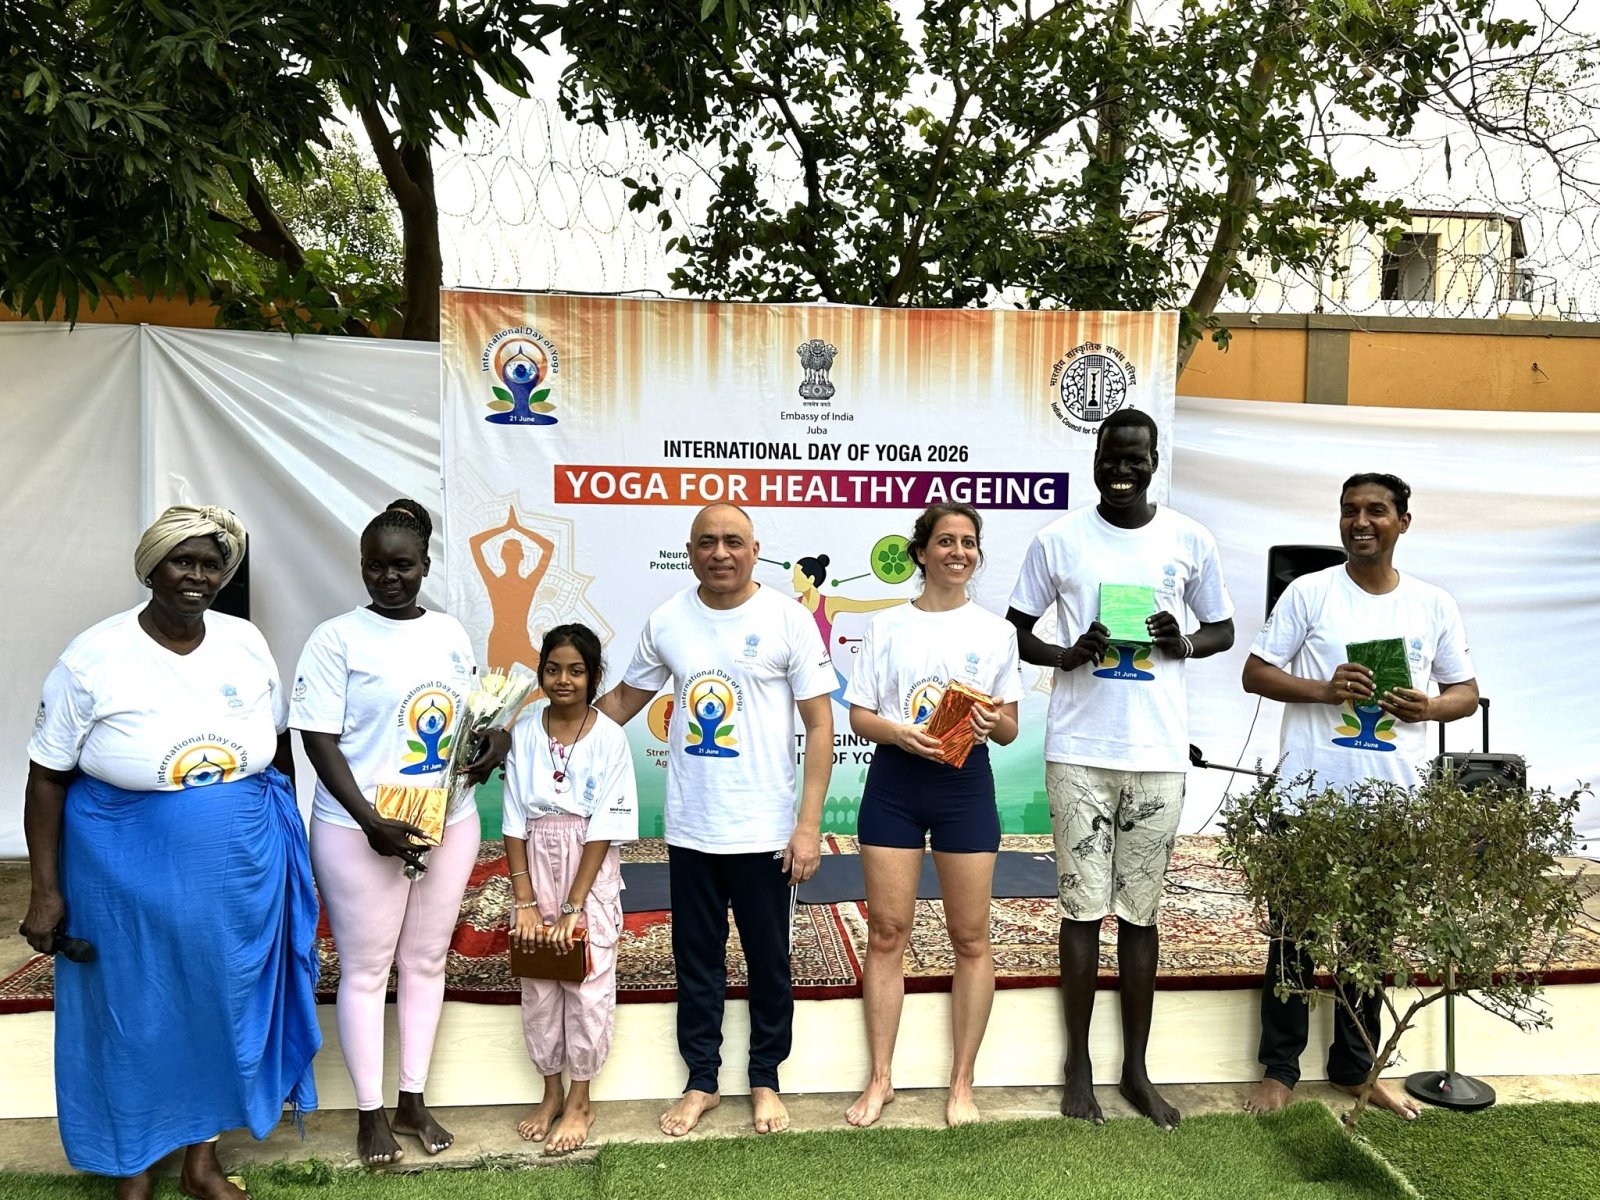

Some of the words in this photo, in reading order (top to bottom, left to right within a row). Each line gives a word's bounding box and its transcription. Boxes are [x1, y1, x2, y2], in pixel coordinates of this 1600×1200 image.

[482, 326, 523, 372] International
[525, 327, 543, 340] Day
[544, 340, 554, 349] of
[551, 349, 559, 374] Yoga
[780, 411, 819, 423] Embassy
[820, 412, 830, 421] of
[832, 412, 854, 421] India
[806, 426, 828, 435] Juba
[1051, 401, 1064, 419] Indian
[1062, 417, 1083, 433] Council
[1081, 427, 1091, 435] for
[663, 440, 802, 461] INTERNATIONAL
[808, 443, 842, 461] DAY
[847, 444, 870, 462] OF
[877, 444, 923, 462] YOGA
[927, 445, 969, 463] 2026
[564, 470, 669, 500] YOGA
[679, 473, 750, 502] FOR
[760, 475, 915, 504] HEALTHY
[924, 477, 1056, 505] AGEING
[650, 561, 693, 570] Protectio
[682, 669, 715, 709] International
[716, 669, 731, 681] Day
[731, 681, 740, 689] of
[932, 675, 948, 689] Day
[397, 681, 434, 727] International
[435, 681, 451, 692] Day
[452, 691, 460, 699] of
[157, 733, 205, 784] International
[208, 733, 229, 745] Day
[230, 742, 243, 751] of
[239, 750, 248, 772] Yoga
